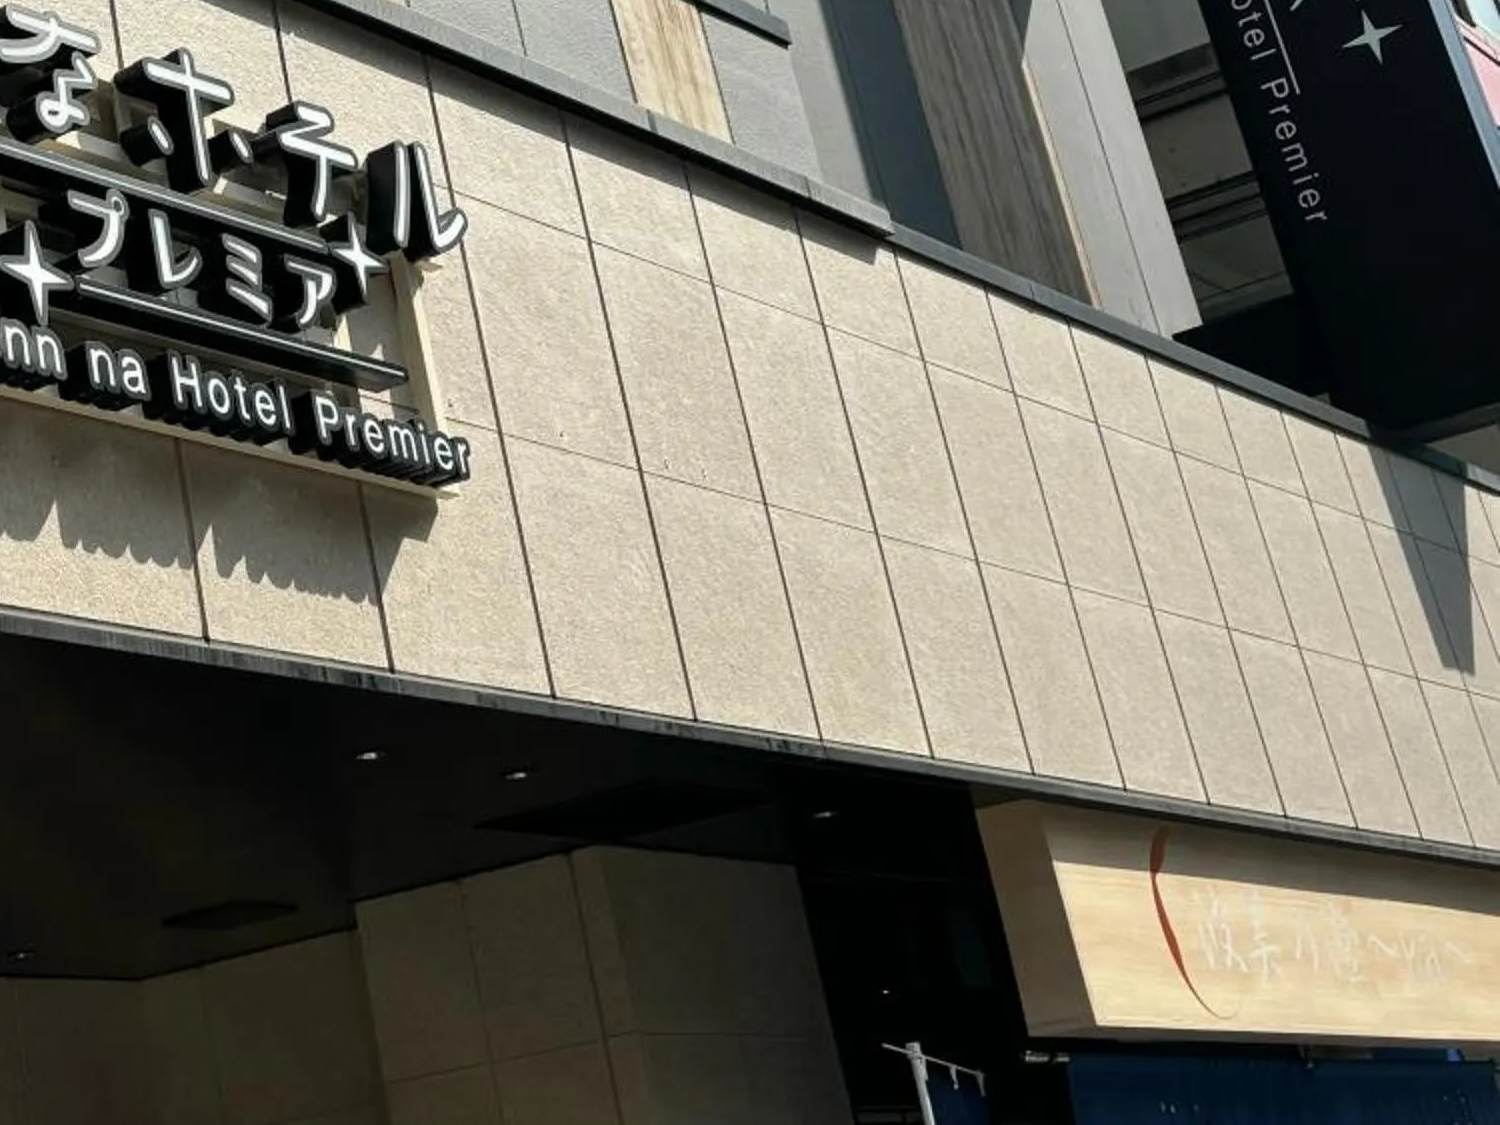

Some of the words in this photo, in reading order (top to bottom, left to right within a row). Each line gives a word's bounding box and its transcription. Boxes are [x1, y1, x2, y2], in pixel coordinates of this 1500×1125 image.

[1259, 76, 1328, 224] Premier
[67, 189, 337, 326] プレミア
[86, 341, 149, 397] na
[171, 355, 294, 431] Hotel
[313, 396, 470, 475] Premier
